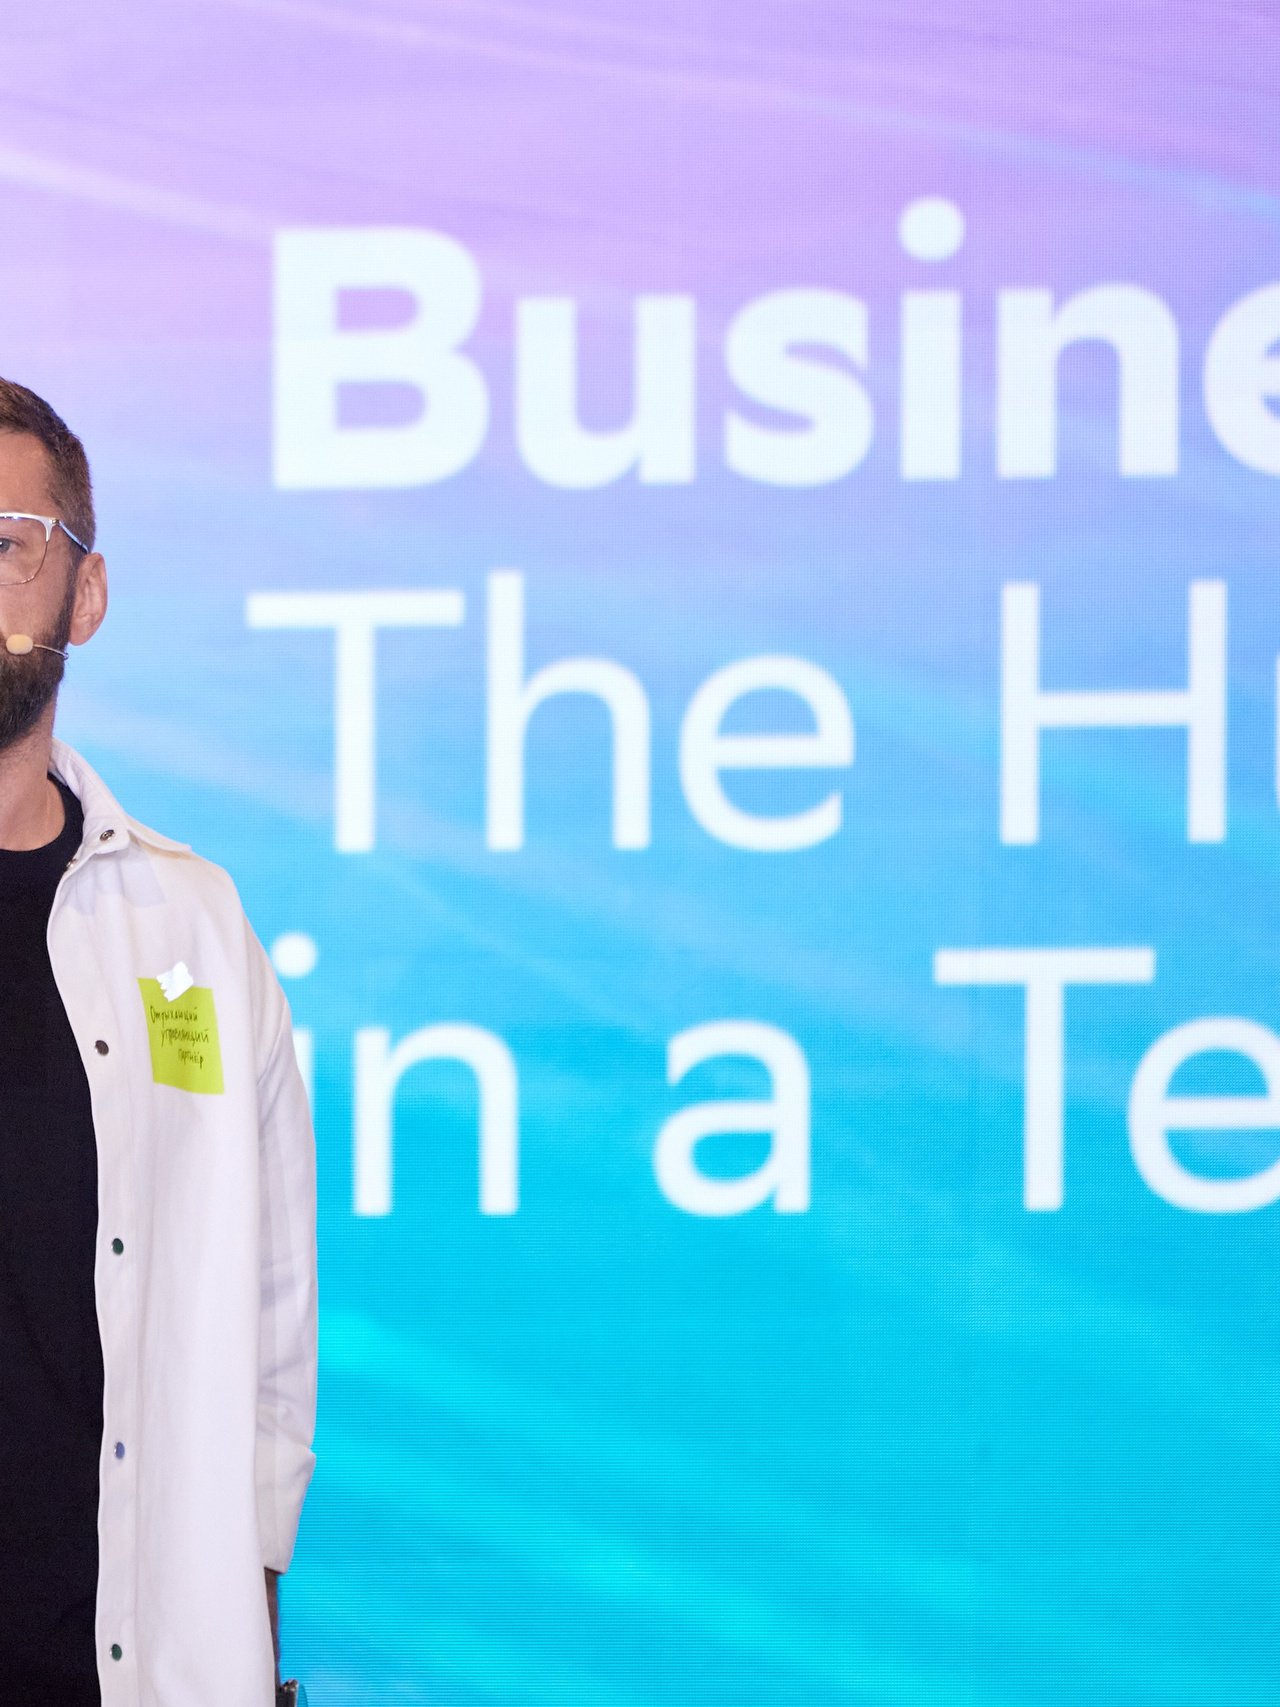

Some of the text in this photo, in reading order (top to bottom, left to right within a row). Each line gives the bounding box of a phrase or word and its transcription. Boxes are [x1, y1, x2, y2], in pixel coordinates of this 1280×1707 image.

[247, 570, 1280, 853] The H
[651, 1018, 811, 1217] a
